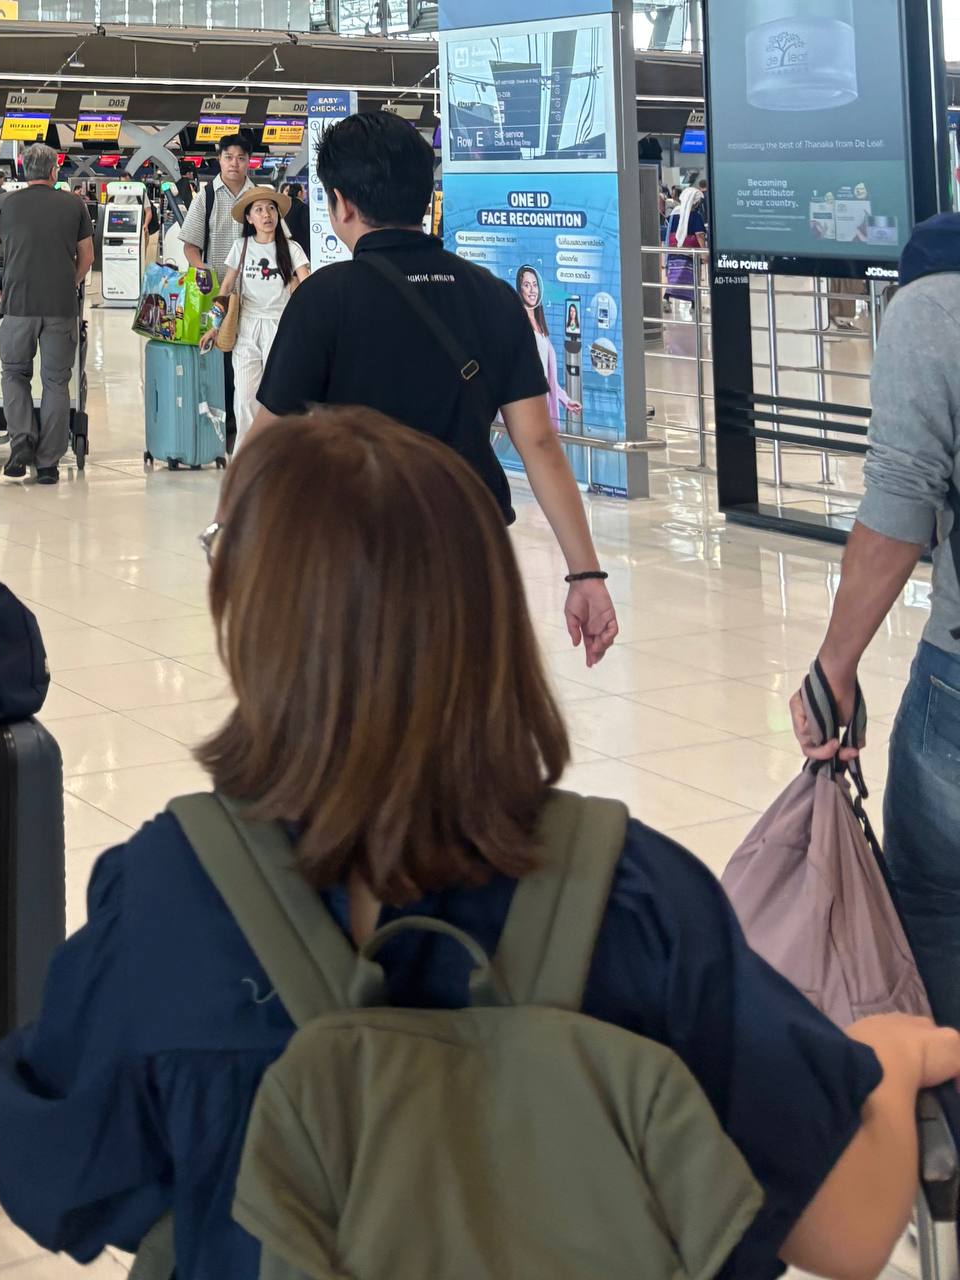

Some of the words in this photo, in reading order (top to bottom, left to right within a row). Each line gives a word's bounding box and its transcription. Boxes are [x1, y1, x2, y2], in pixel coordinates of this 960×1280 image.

[10, 96, 28, 104] D04
[108, 98, 125, 107] D05
[204, 101, 221, 110] D06
[457, 136, 473, 147] Row
[476, 131, 484, 147] E
[766, 141, 778, 149] the
[747, 178, 788, 189] Becoming
[752, 188, 795, 197] distributor
[510, 192, 535, 207] ONE
[537, 193, 549, 208] ID
[736, 197, 744, 206] in
[746, 199, 763, 208] your
[481, 212, 507, 225] FACE
[509, 212, 582, 227] RECOGNITION
[717, 259, 739, 269] KING
[740, 260, 769, 270] POWER
[865, 266, 899, 278] JCDeca
